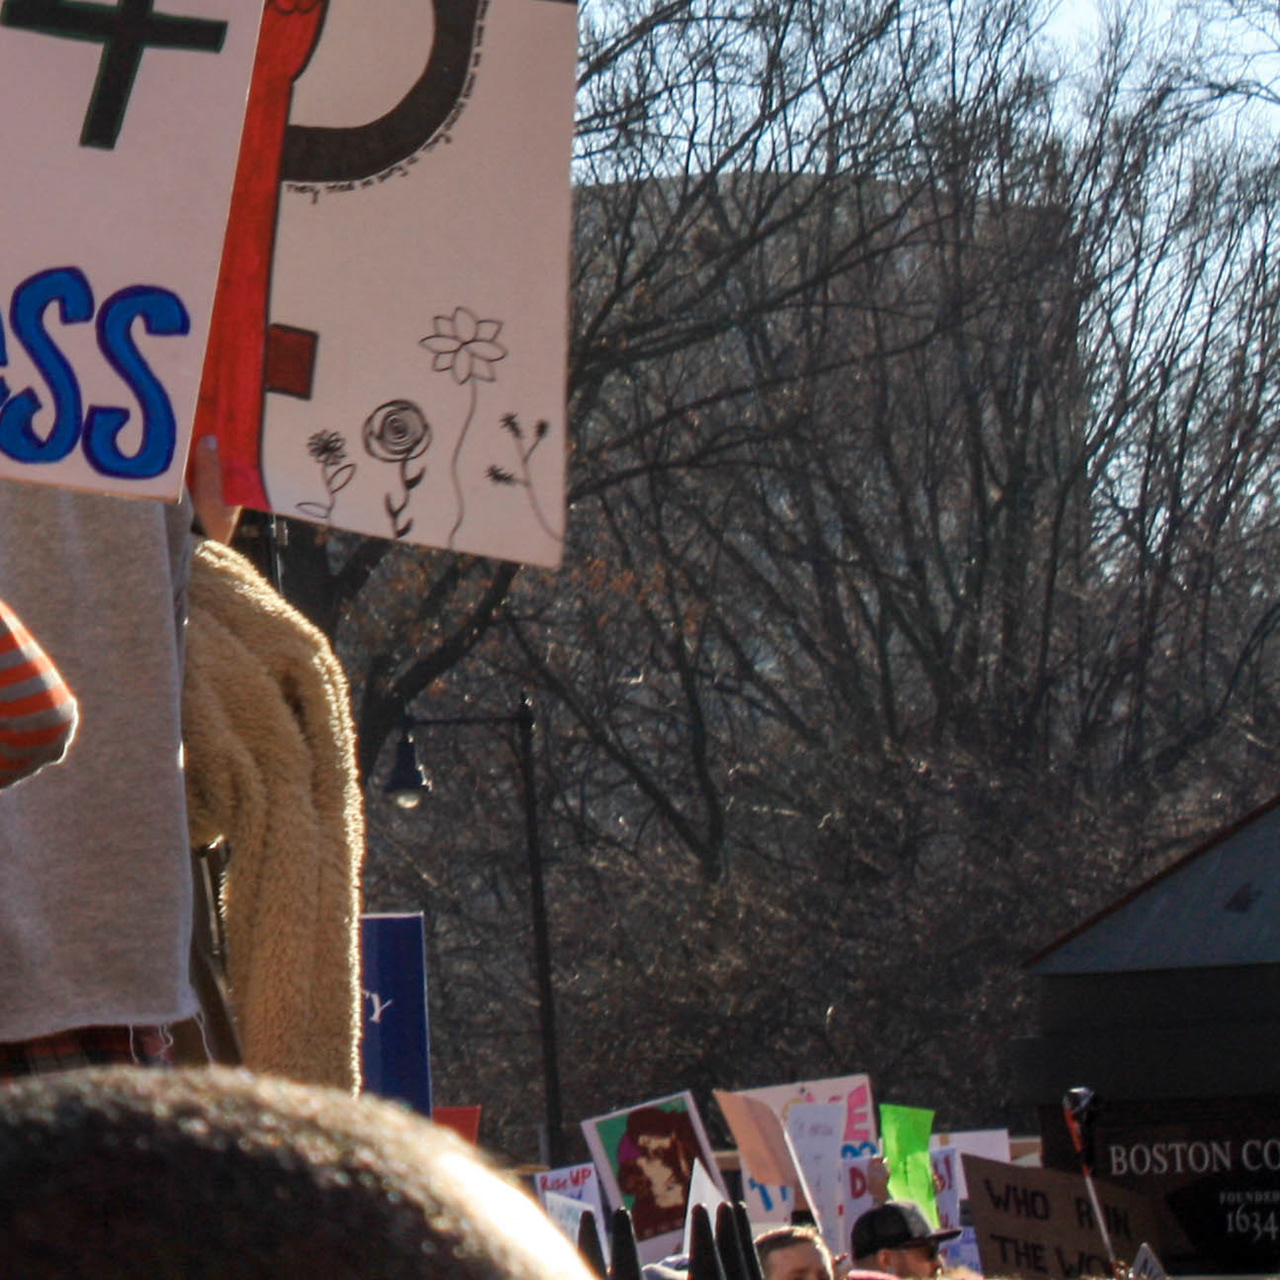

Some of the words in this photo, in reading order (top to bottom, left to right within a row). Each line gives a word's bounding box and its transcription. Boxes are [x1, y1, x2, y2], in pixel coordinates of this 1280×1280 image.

[1108, 1139, 1233, 1176] BOSTON
[1241, 1138, 1280, 1171] CO
[983, 1178, 1051, 1221] WHO
[1226, 1202, 1279, 1243] 1634
[989, 1233, 1048, 1273] THE
